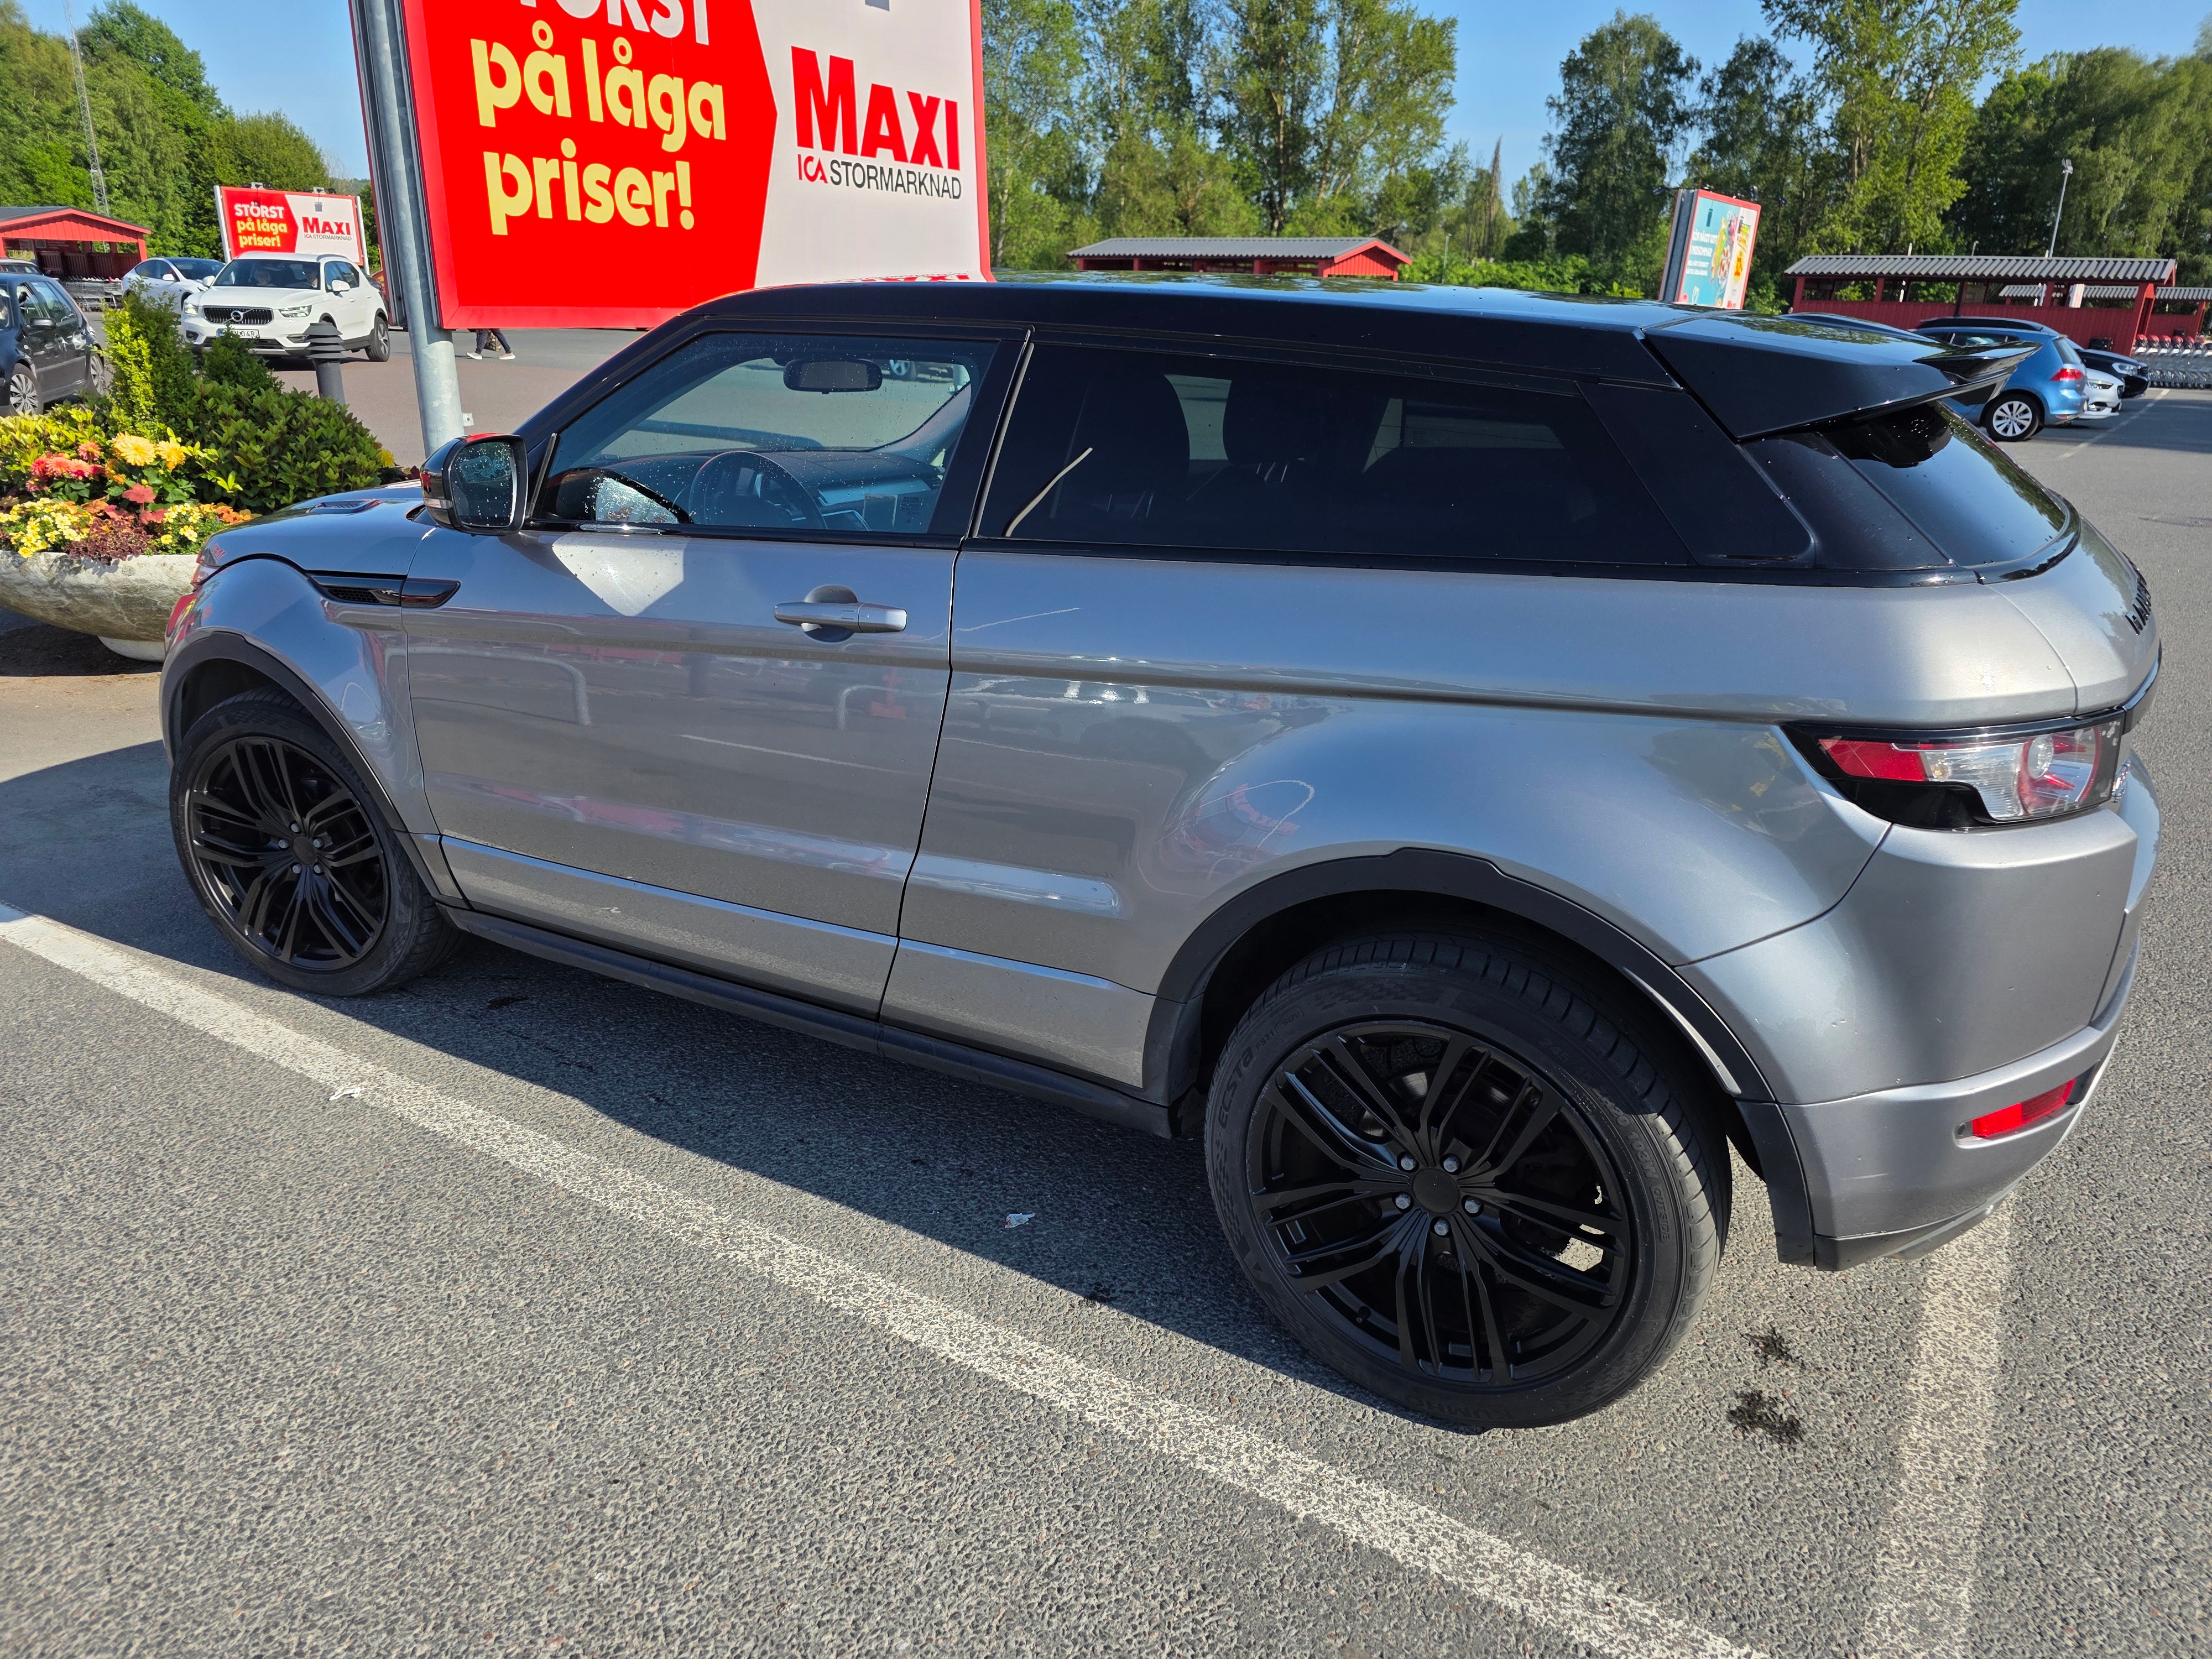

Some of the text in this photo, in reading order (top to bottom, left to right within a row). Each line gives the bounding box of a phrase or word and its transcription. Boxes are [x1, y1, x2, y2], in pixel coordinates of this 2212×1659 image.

[471, 20, 726, 152] på låga
[791, 45, 960, 171] MAXI
[483, 138, 695, 236] priser!
[797, 154, 962, 200] ICA STORMARKNAD
[234, 201, 284, 219] STÖRST
[237, 217, 288, 235] på låga
[302, 216, 351, 236] MAXI
[239, 233, 281, 248] priser!
[1625, 1131, 1659, 1179] 103W
[1652, 1187, 1671, 1242] OUTSIDE
